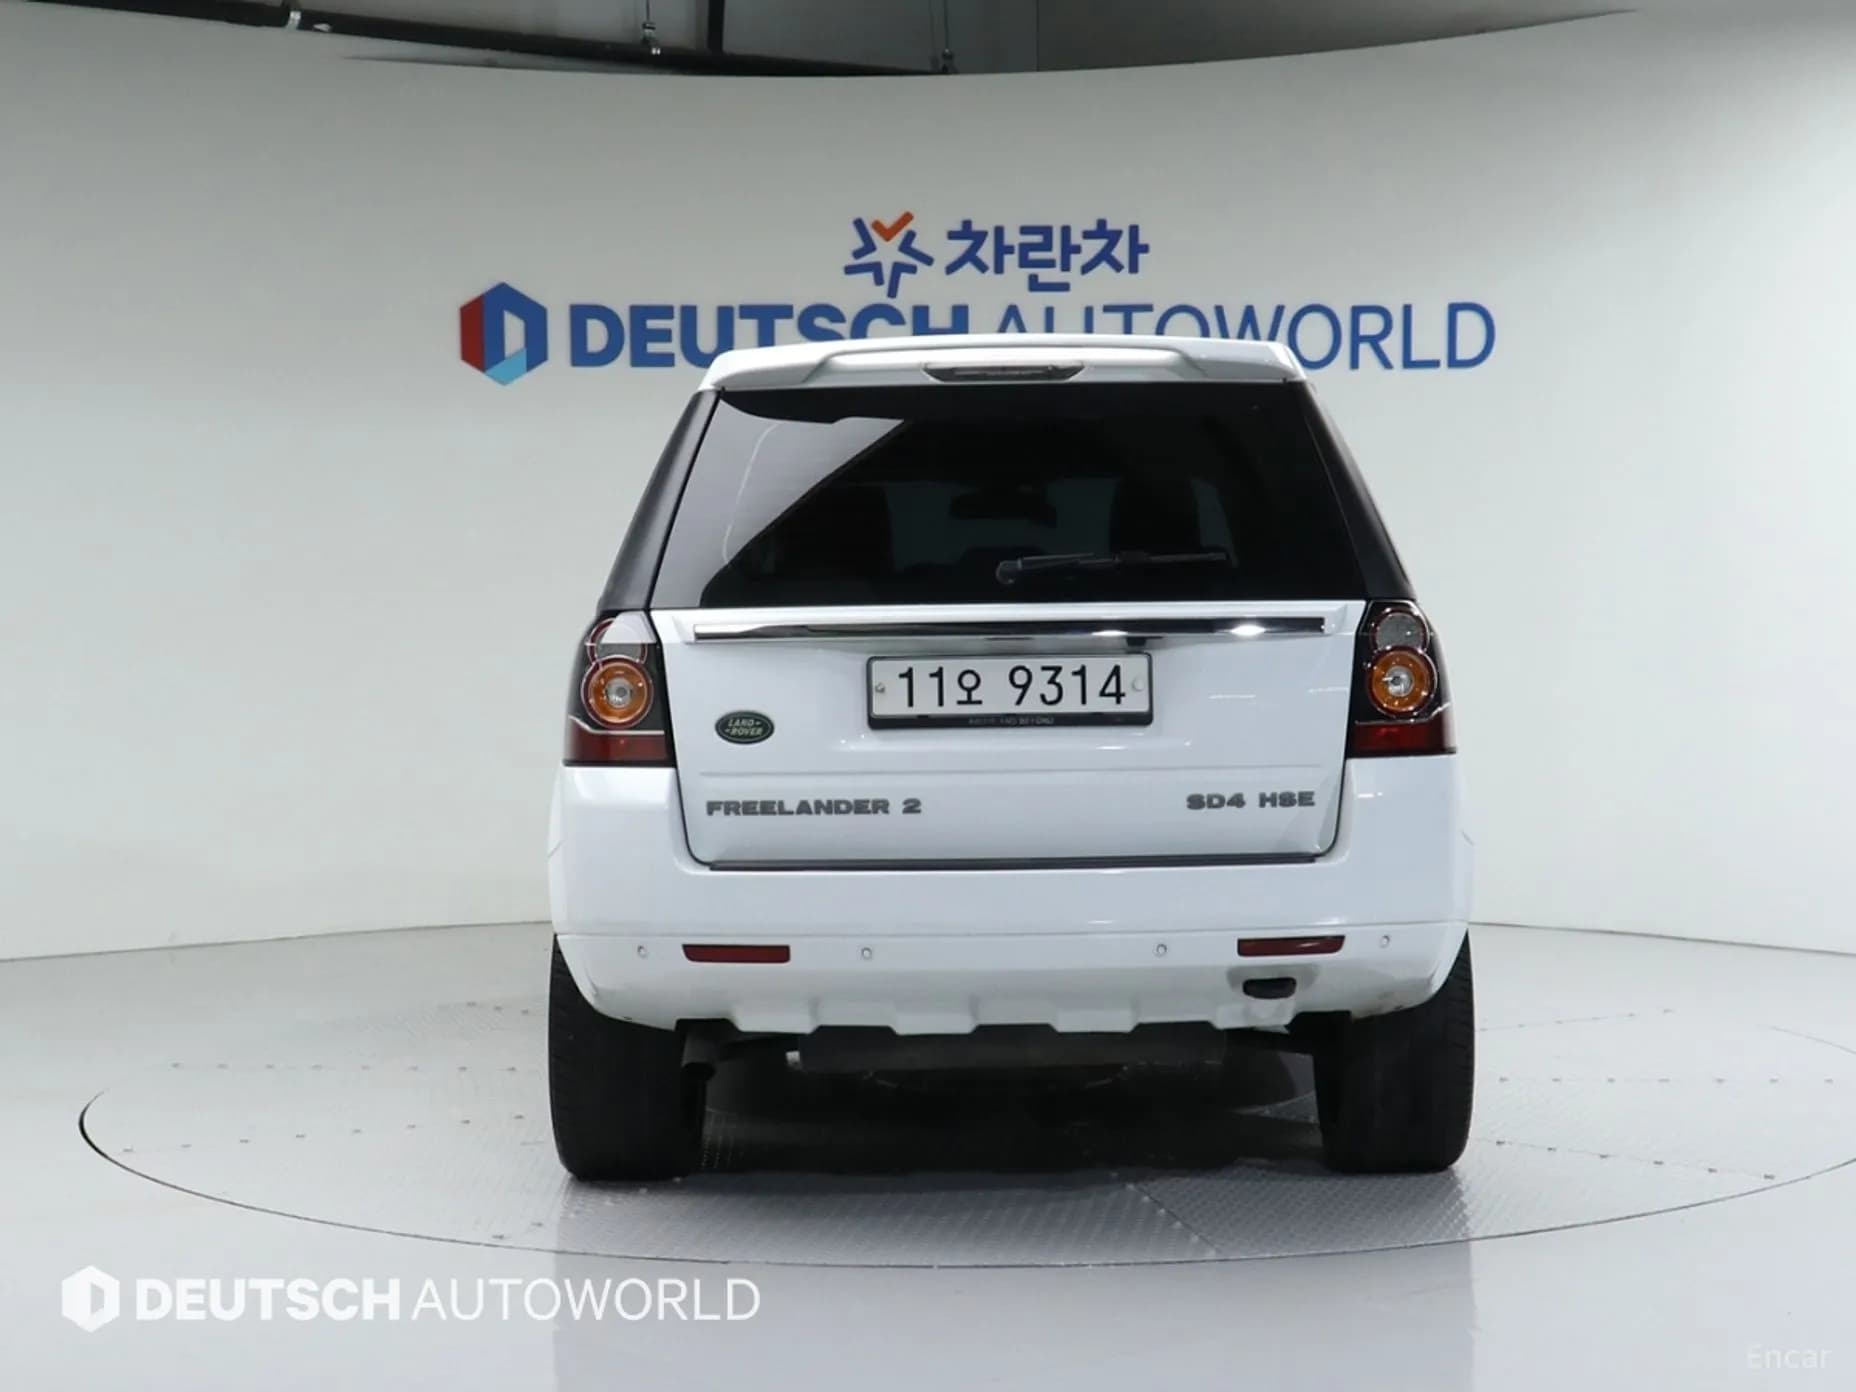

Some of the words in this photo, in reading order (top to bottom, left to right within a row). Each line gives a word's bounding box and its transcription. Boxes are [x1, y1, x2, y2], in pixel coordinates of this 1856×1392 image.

[944, 218, 1150, 293] 차란차
[898, 666, 983, 708] 11오
[1008, 664, 1126, 706] 9314
[706, 799, 890, 816] FREELANDER
[902, 798, 922, 814] 2
[1186, 792, 1246, 810] SD4
[1259, 791, 1315, 808] HSE
